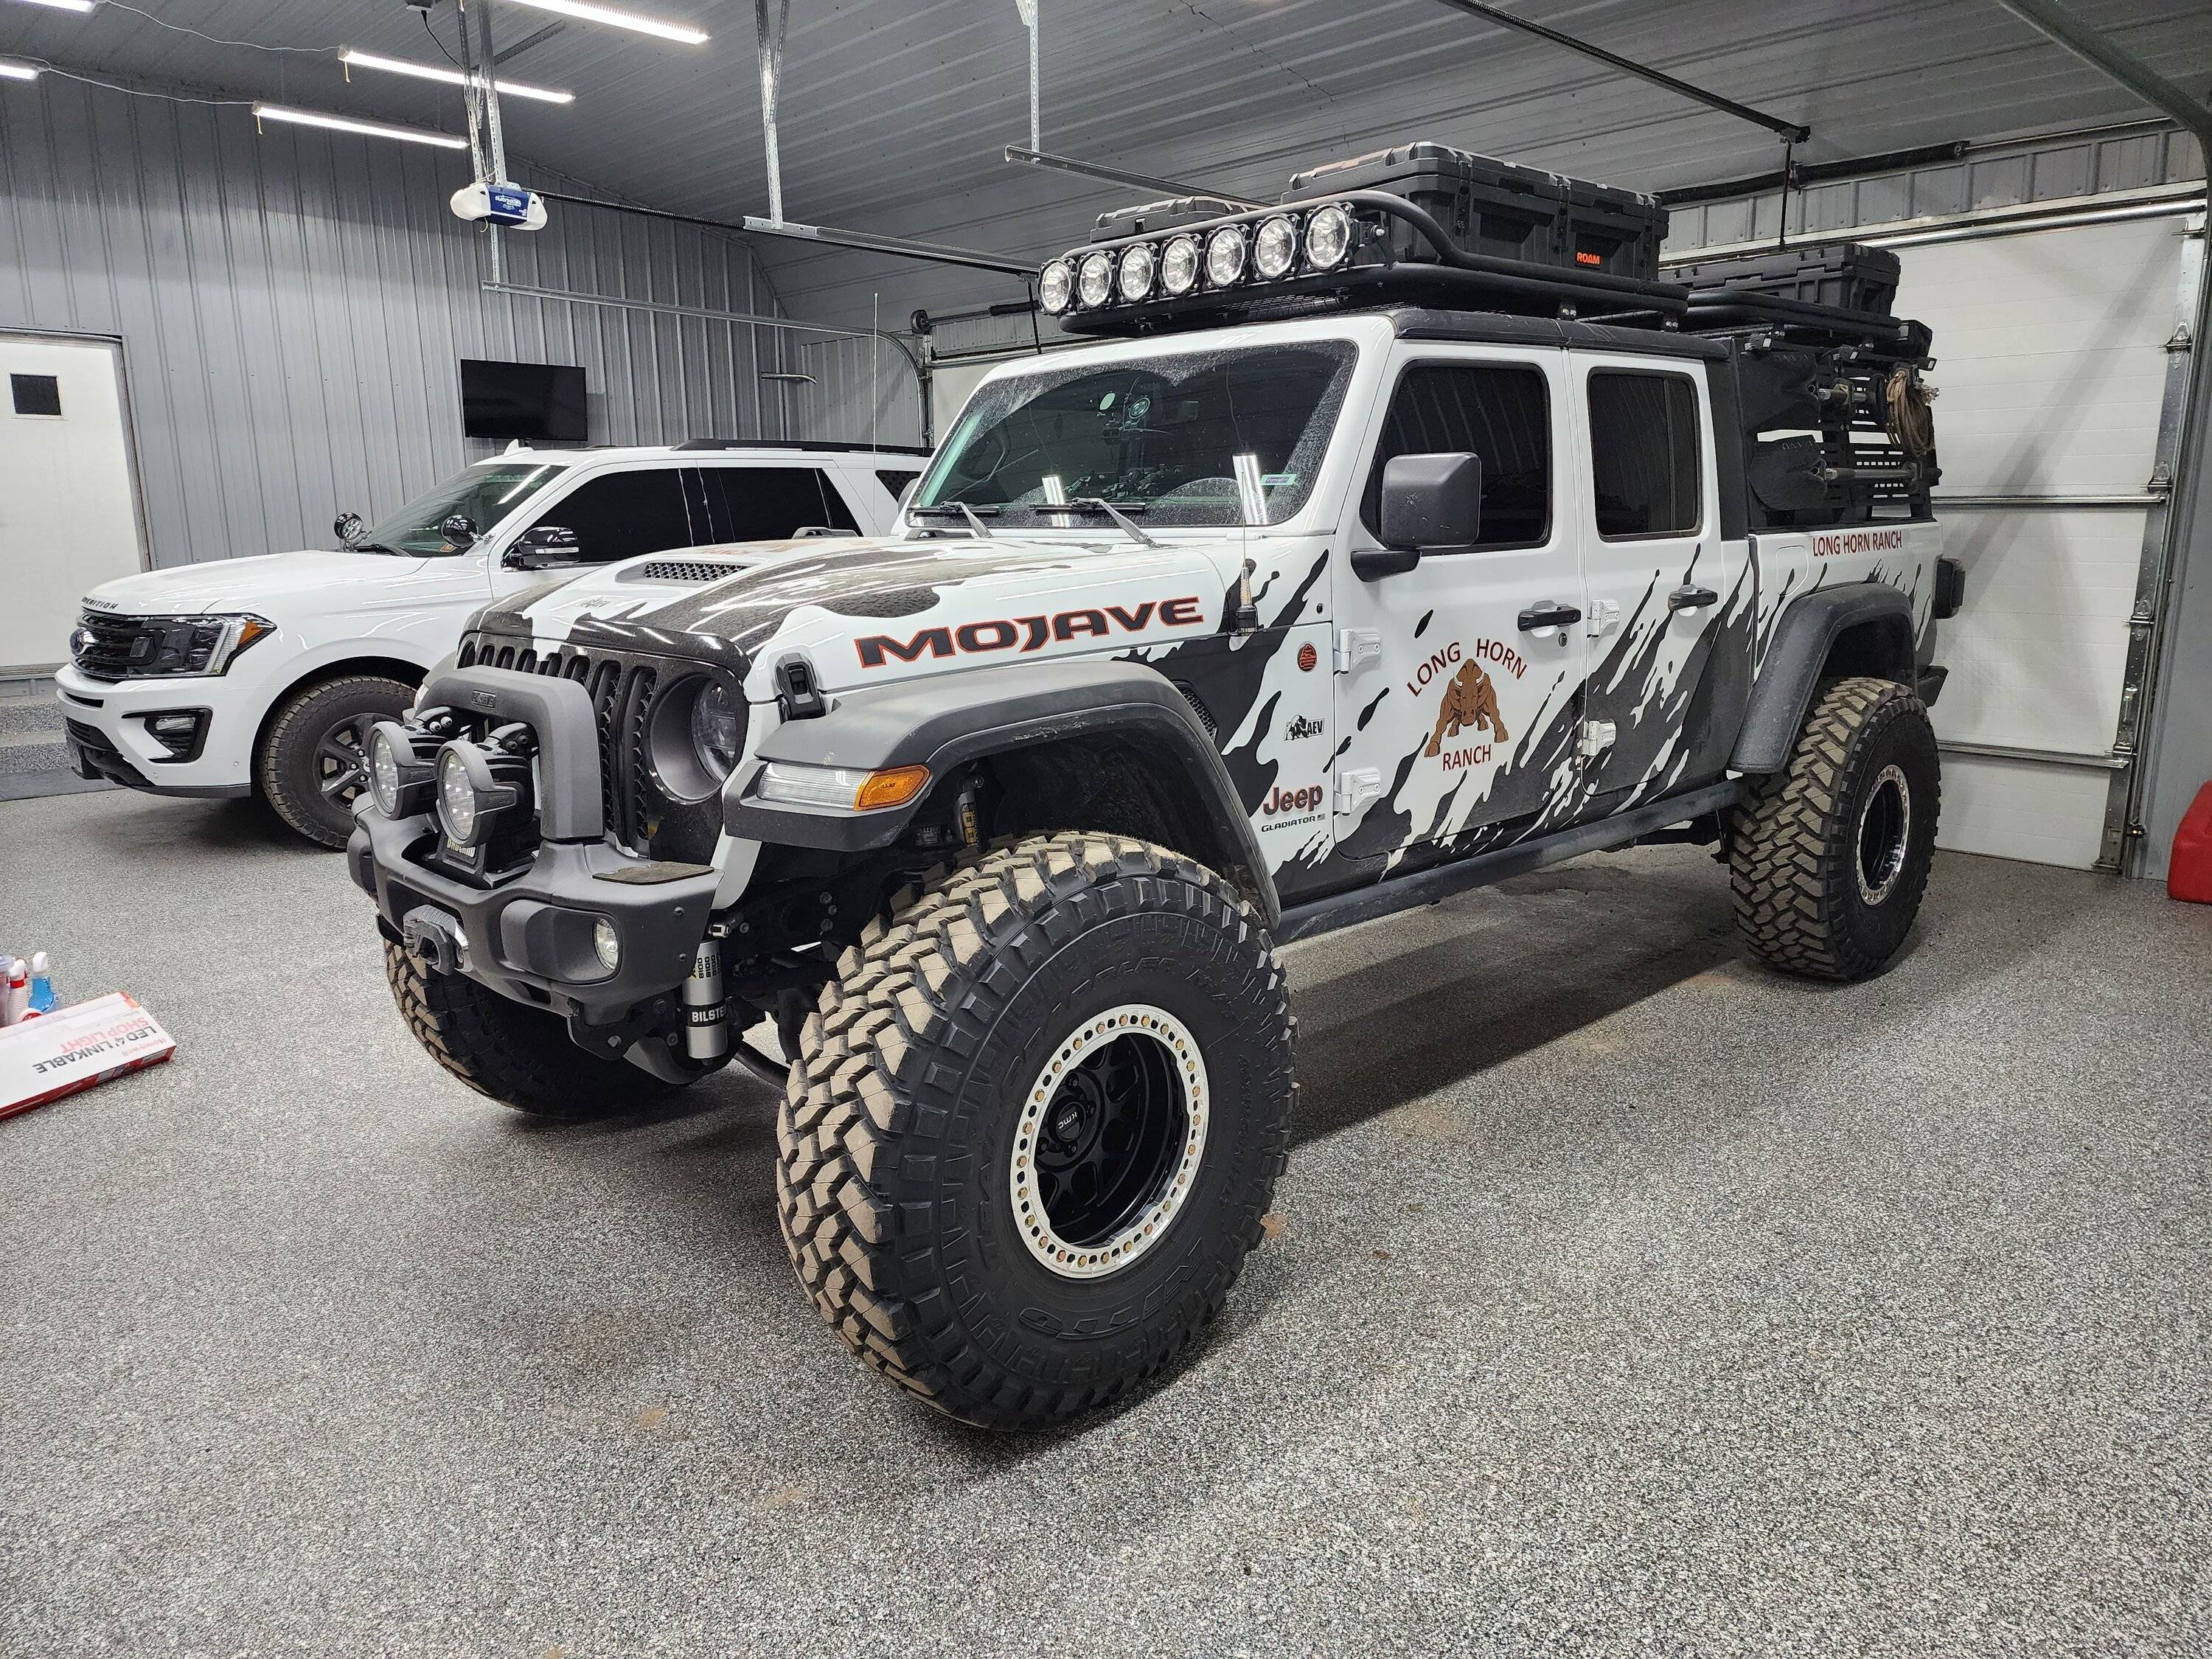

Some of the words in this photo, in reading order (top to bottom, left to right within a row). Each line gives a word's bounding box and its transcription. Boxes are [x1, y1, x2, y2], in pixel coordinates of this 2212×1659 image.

[1576, 251, 1601, 265] ROAM
[1813, 535, 1840, 557] LONG
[1843, 532, 1871, 554] HORN
[1873, 530, 1902, 552] RANCH
[854, 597, 1203, 668] MOJAVE
[1407, 641, 1461, 697] LONG
[1476, 638, 1528, 680] HORN
[1307, 720, 1323, 735] AEV
[1442, 743, 1492, 772] RANCH
[1262, 784, 1324, 816] Jeep
[1261, 815, 1316, 832] GLADIATOR
[692, 1006, 725, 1023] BILSTE
[106, 1017, 150, 1037] SHOP
[126, 1026, 157, 1042] LED
[59, 1031, 106, 1054] LIGHT
[32, 1040, 114, 1074] LINKABLE
[1057, 1111, 1077, 1130] KMC
